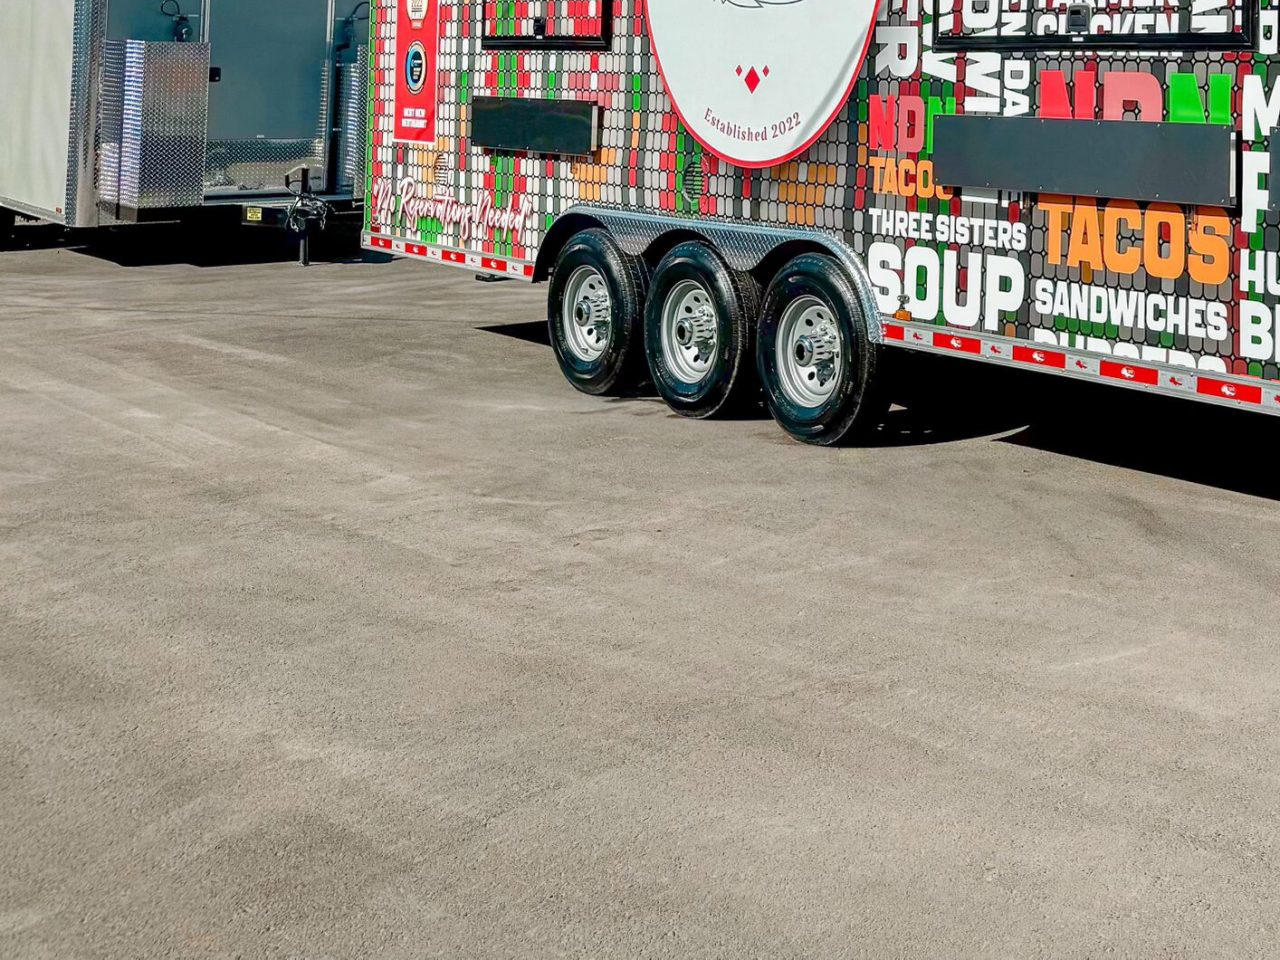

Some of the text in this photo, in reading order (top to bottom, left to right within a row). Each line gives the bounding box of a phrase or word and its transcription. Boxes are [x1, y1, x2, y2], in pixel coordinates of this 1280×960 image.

[703, 106, 802, 142] Established 2022
[867, 207, 1028, 253] THREE SISTERS
[1036, 192, 1232, 287] TACOS
[867, 241, 1026, 332] SOUP
[1034, 278, 1229, 341] SANDWICHES
